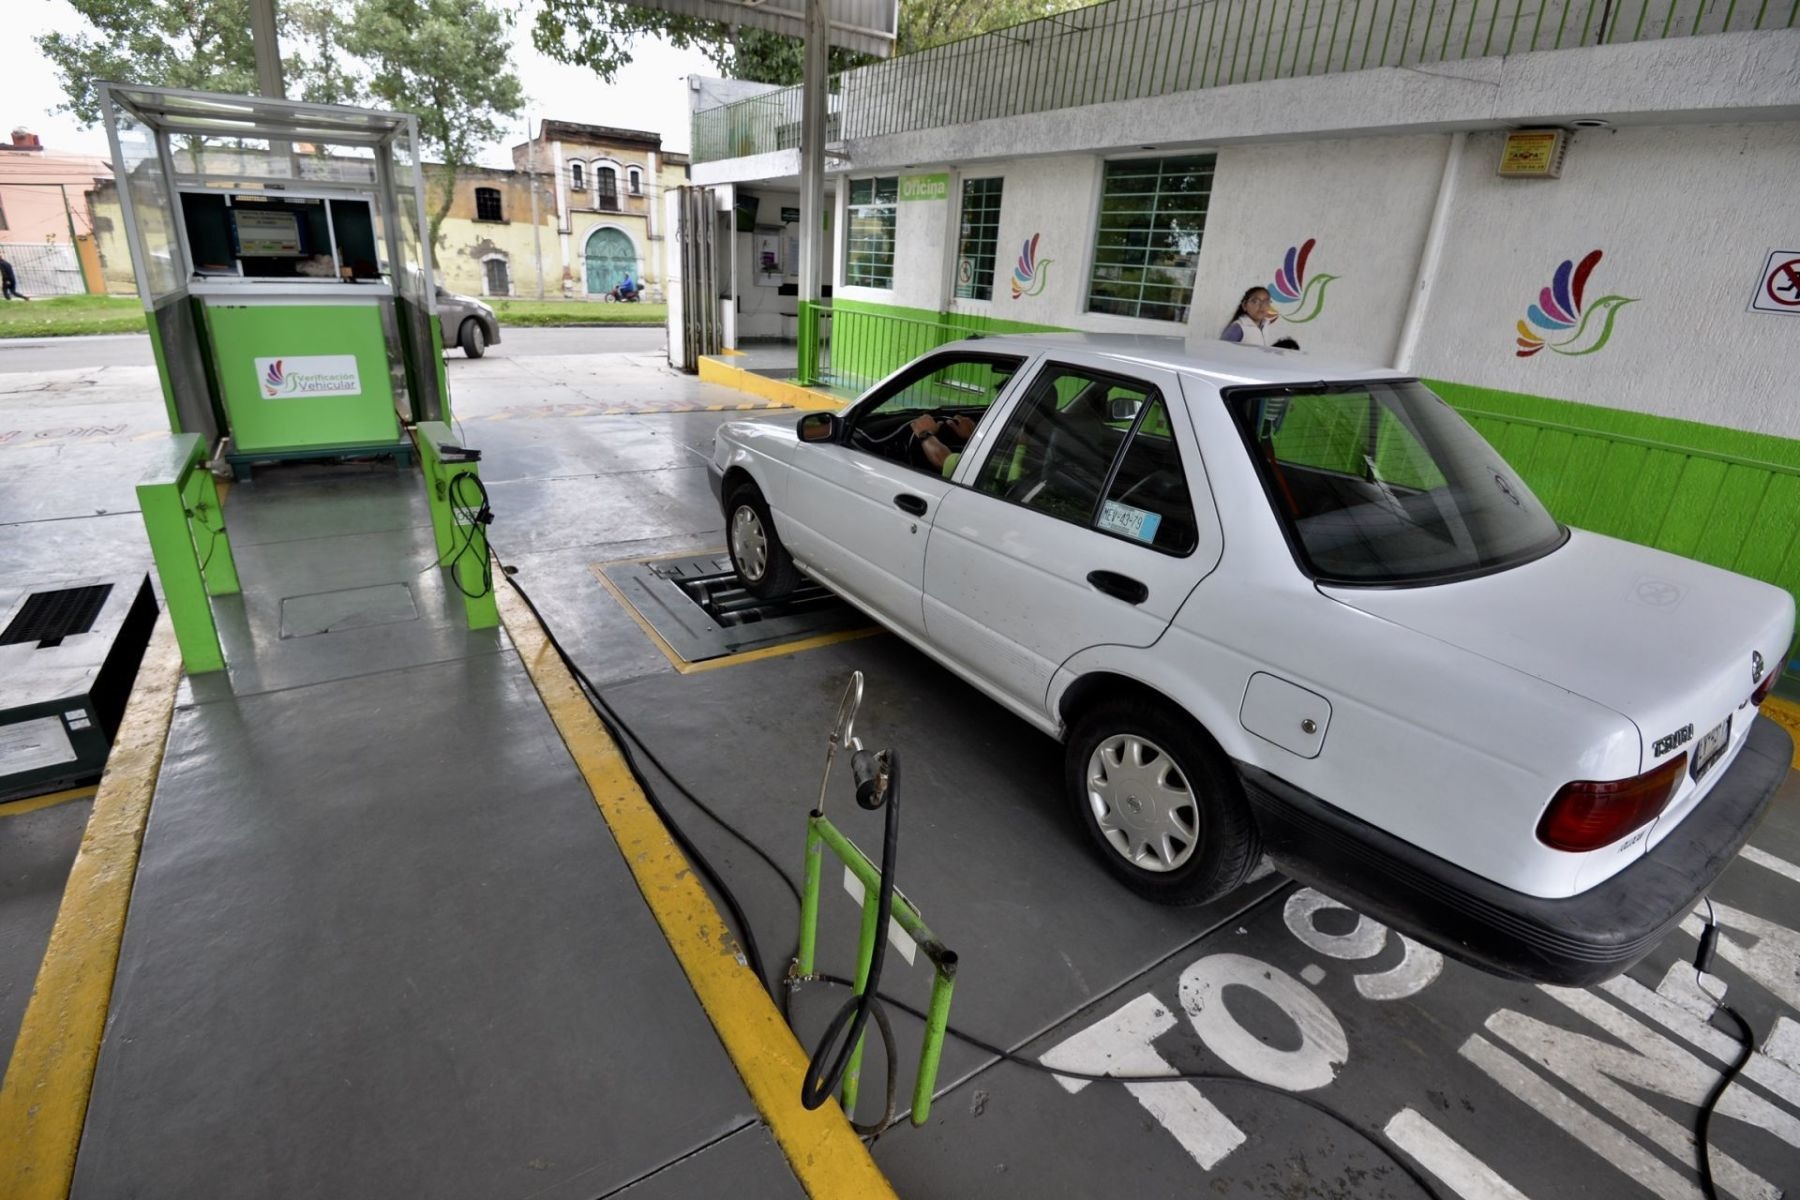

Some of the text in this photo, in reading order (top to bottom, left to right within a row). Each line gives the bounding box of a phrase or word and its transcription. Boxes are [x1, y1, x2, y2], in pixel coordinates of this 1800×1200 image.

[903, 180, 945, 197] Oficina
[297, 373, 355, 382] Verificación
[299, 380, 356, 391] Vehicular
